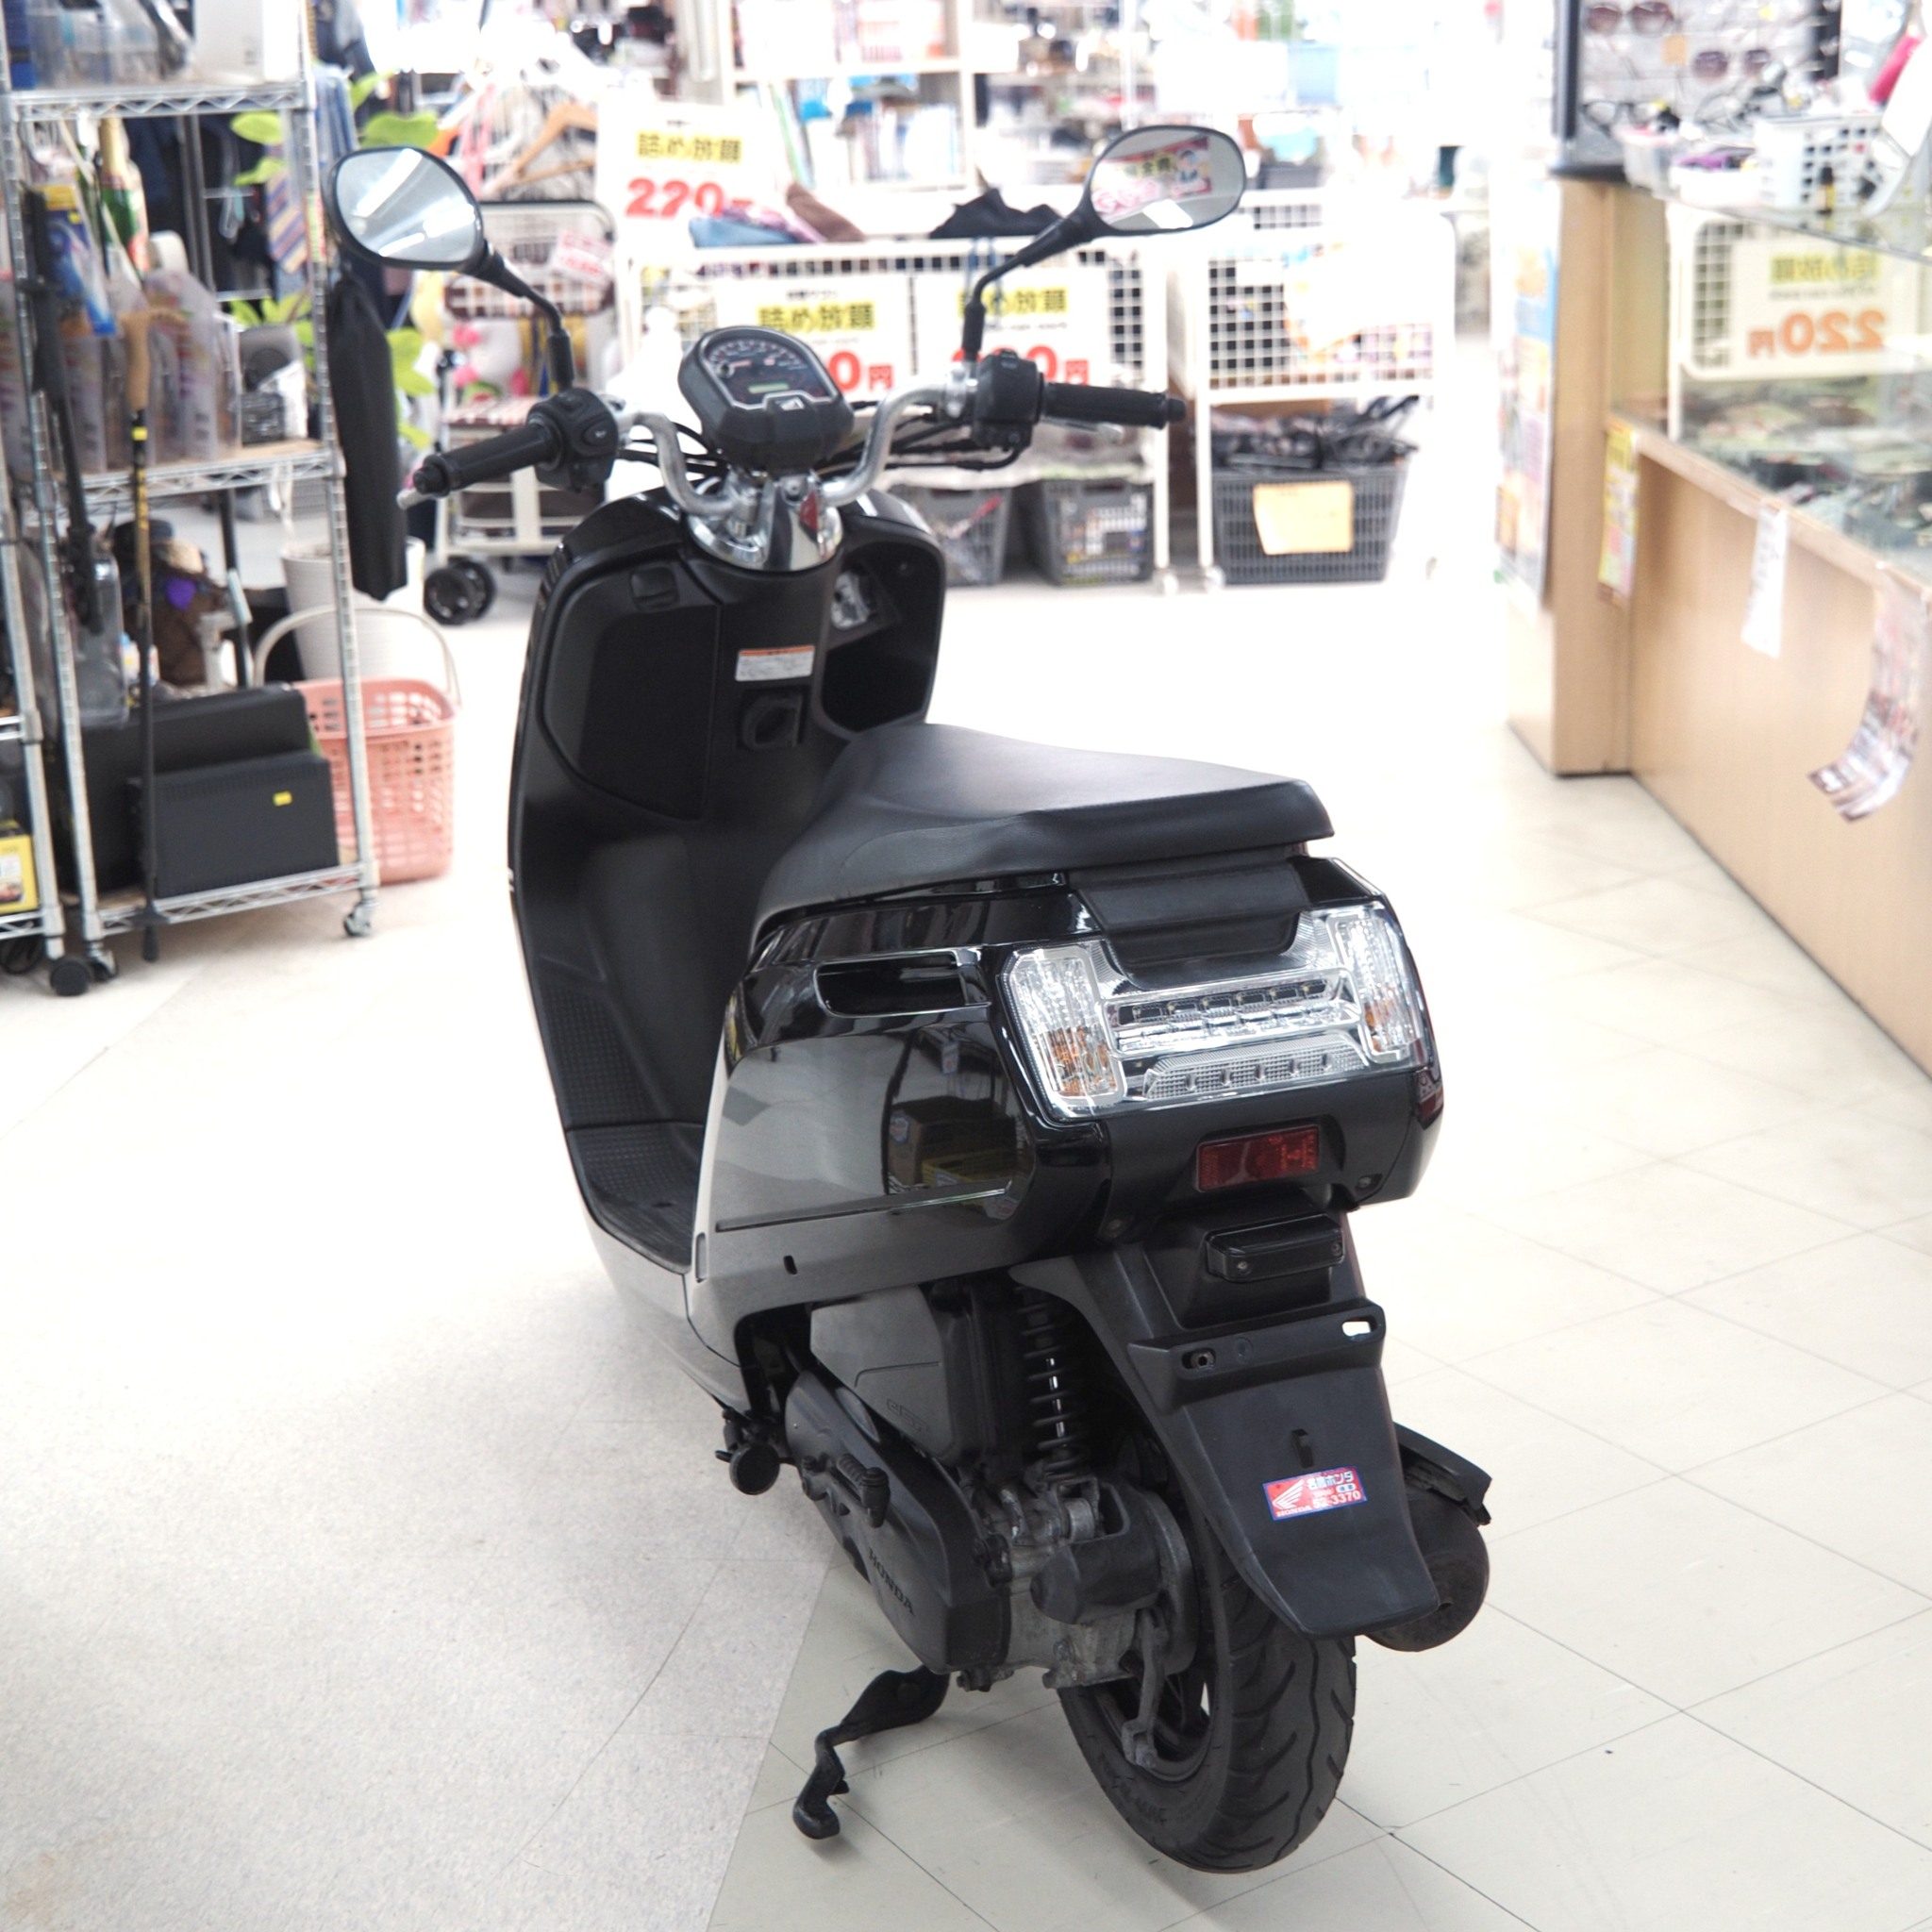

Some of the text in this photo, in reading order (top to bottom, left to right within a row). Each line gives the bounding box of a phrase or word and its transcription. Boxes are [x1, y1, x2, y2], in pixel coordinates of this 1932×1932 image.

[625, 177, 754, 218] 220
[957, 289, 1068, 316] め放題
[1275, 1506, 1312, 1518] HONDA
[1312, 1491, 1362, 1508] 52-3370
[868, 1547, 915, 1616] HONDA
